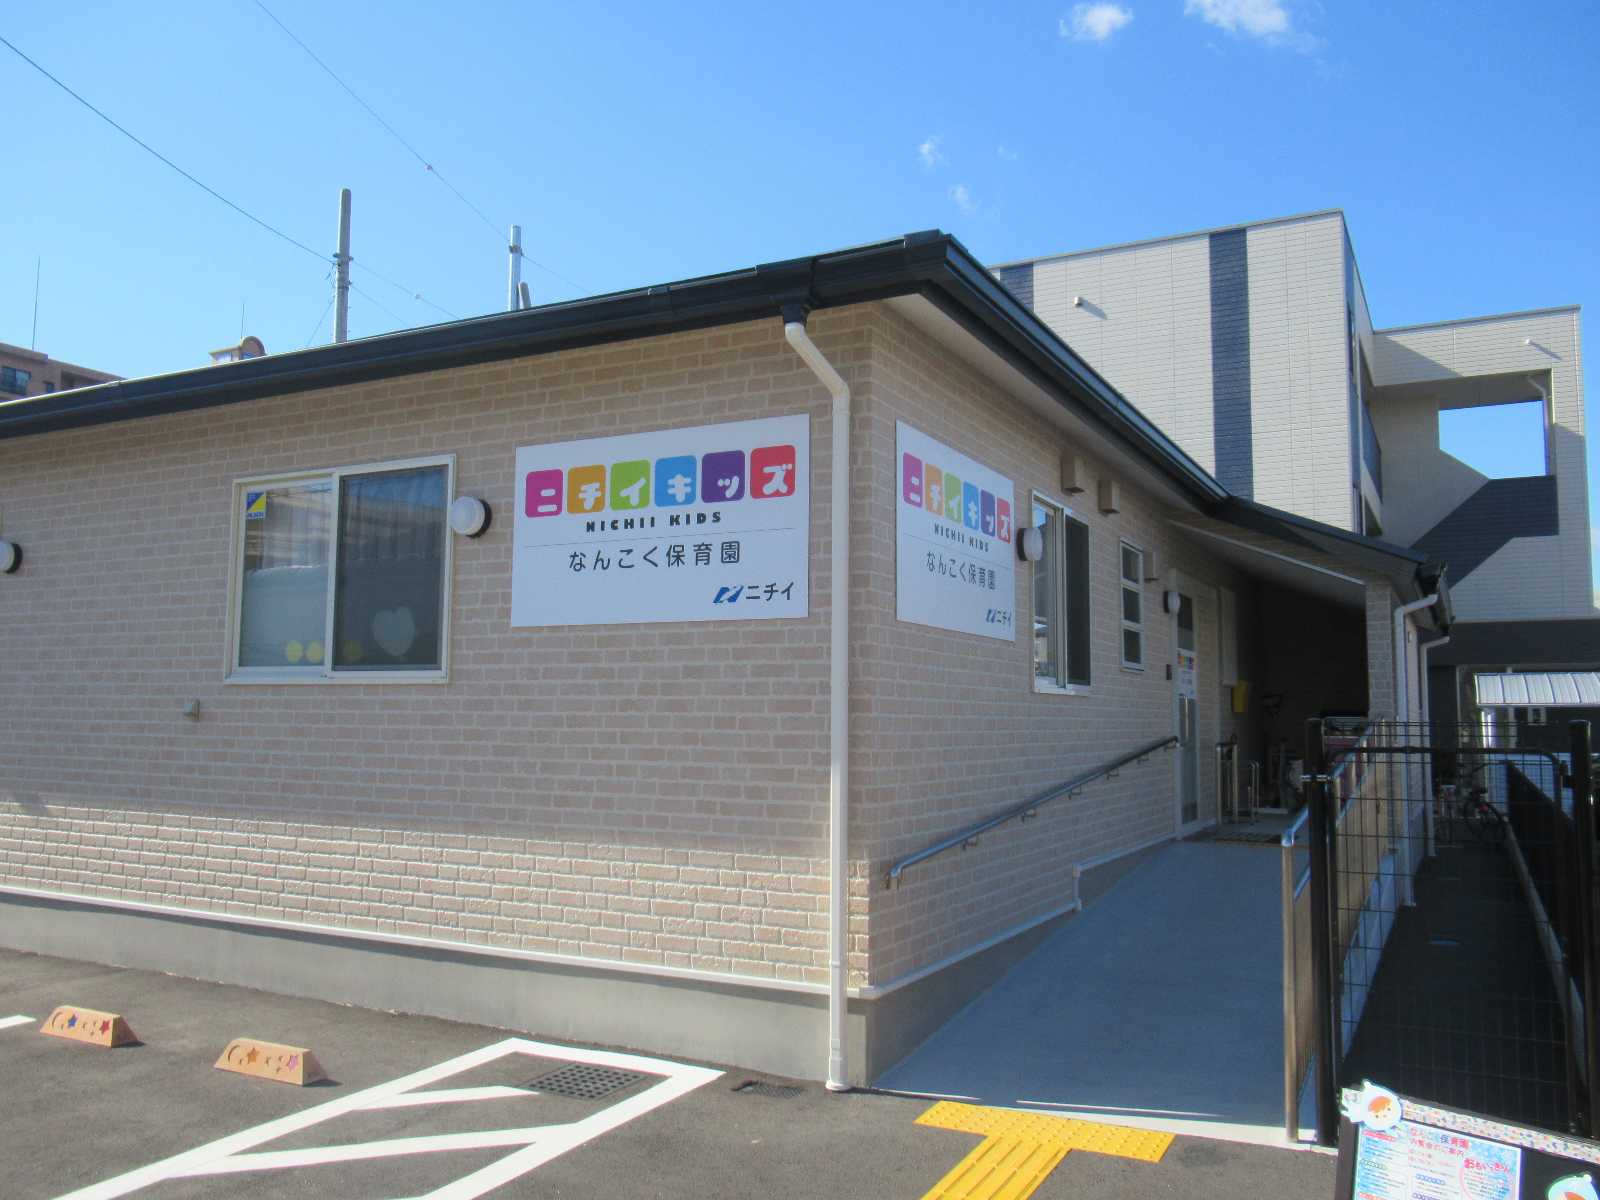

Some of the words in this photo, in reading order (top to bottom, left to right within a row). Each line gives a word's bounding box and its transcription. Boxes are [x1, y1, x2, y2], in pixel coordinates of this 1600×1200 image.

[533, 458, 794, 514] ニチイキッズ
[907, 469, 1010, 540] ニチイキッズ
[585, 516, 656, 533] NICHII
[669, 511, 722, 527] KIDS
[934, 522, 965, 544] NICHII
[969, 536, 989, 552] KIDS
[569, 540, 741, 572] なんこく保育園
[926, 551, 996, 590] なんこく保育園
[745, 582, 795, 601] ニチイ
